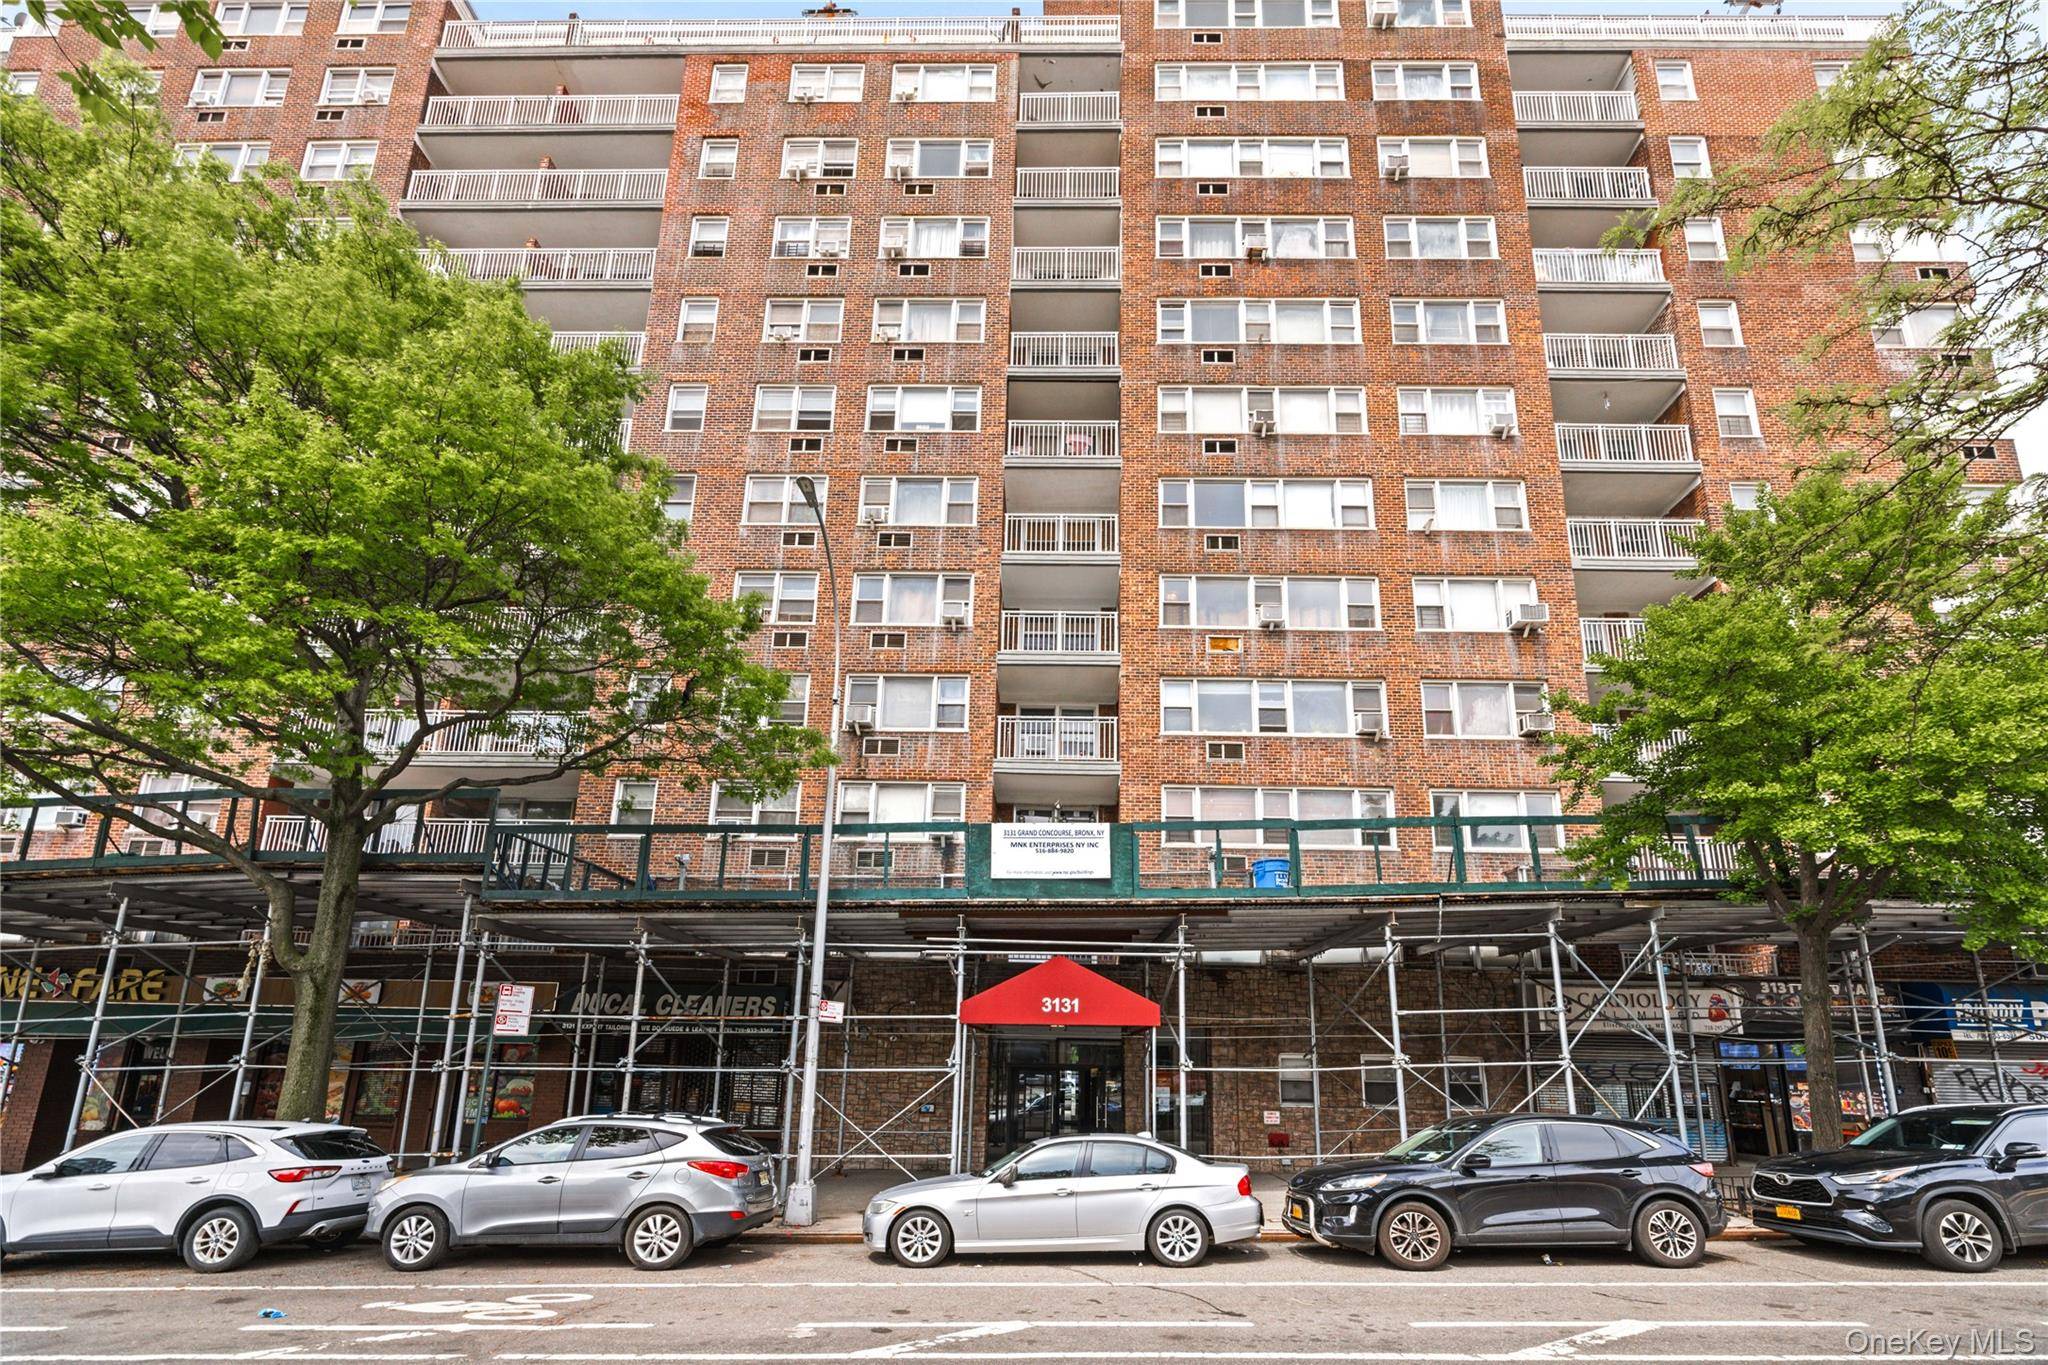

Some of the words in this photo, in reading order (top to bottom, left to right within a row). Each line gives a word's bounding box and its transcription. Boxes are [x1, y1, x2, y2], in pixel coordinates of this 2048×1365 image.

[1003, 829, 1017, 837] 3131
[1017, 829, 1037, 837] GRAND
[1038, 829, 1074, 838] CONCOURSE,
[1074, 829, 1095, 837] BRONX,
[1096, 829, 1105, 837] NY
[71, 967, 166, 1001] FARE
[570, 992, 648, 1015] DUCAL
[655, 993, 777, 1017] CLEANERS
[1041, 997, 1079, 1013] 3131
[1578, 992, 1701, 1009] CARDIOLOGY
[1584, 1010, 1701, 1019] UNLIMIED
[605, 1024, 633, 1032] TAILORIN
